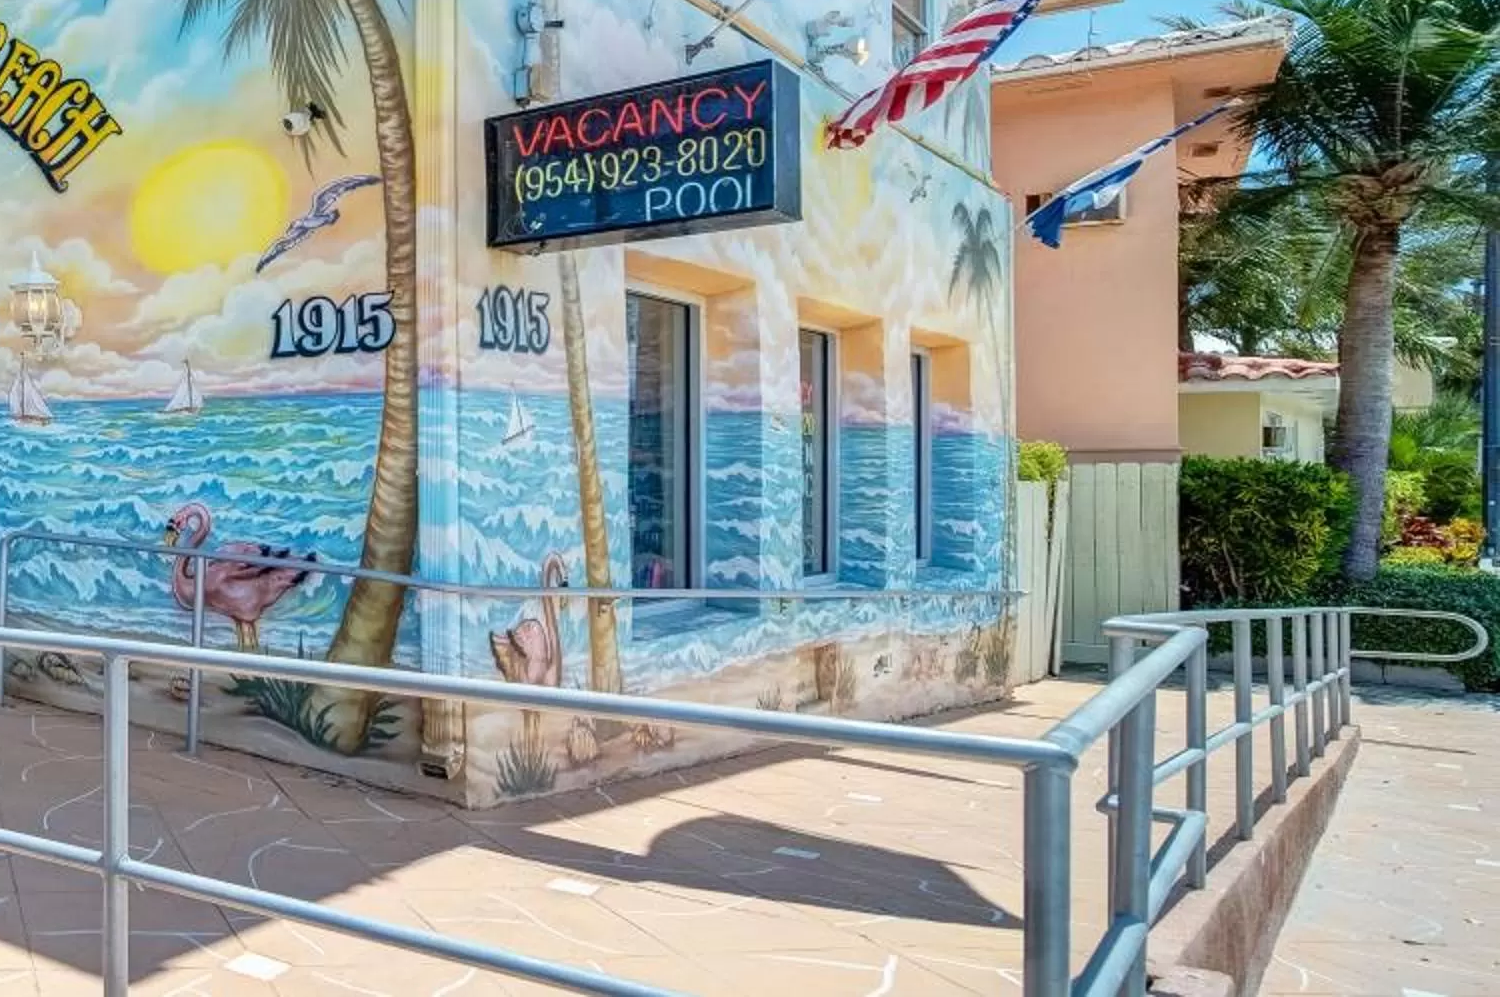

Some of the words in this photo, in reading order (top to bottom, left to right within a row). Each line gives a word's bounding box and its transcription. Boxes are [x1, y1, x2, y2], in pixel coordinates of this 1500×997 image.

[512, 79, 767, 157] VACANCY
[270, 289, 397, 360] 1915
[476, 284, 551, 355] 1915
